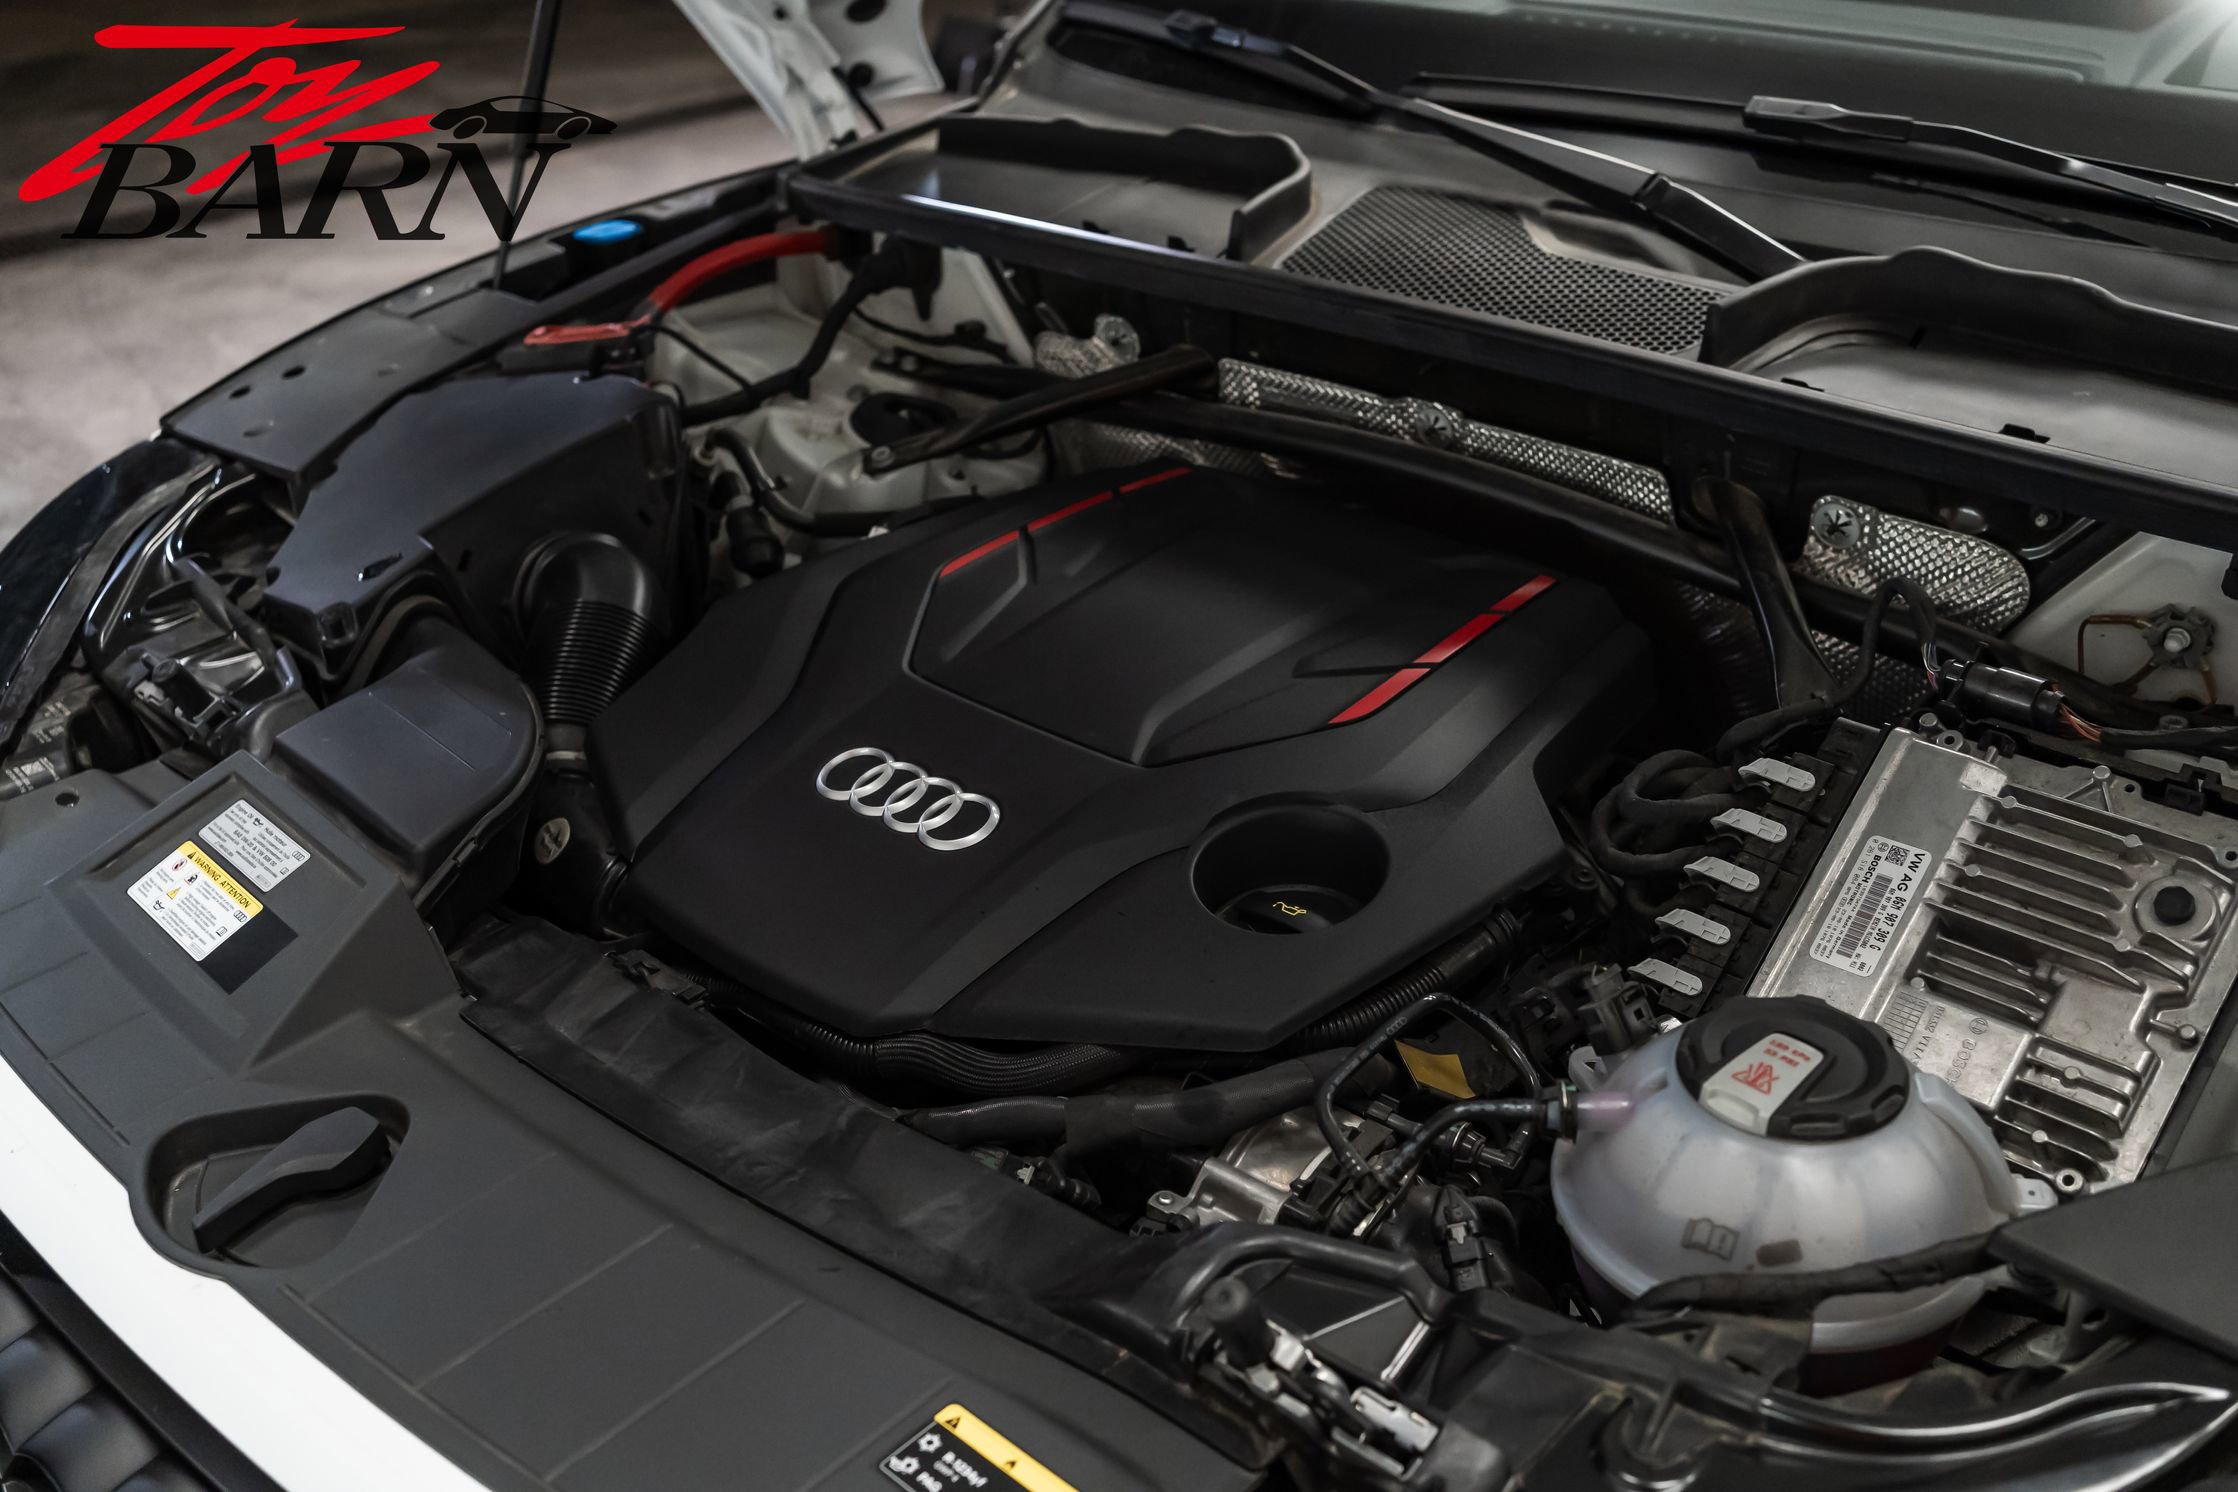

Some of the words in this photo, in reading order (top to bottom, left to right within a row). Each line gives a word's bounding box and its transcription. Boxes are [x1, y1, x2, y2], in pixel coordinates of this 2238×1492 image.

[1860, 854, 1882, 883] BOSCH
[1906, 851, 1925, 872] VW
[192, 855, 221, 881] WARNING
[218, 879, 251, 908] ATTENTION
[1895, 873, 1913, 893] AG
[1841, 914, 1852, 928] Made
[1881, 911, 1898, 927] 907
[1873, 927, 1889, 943] 309
